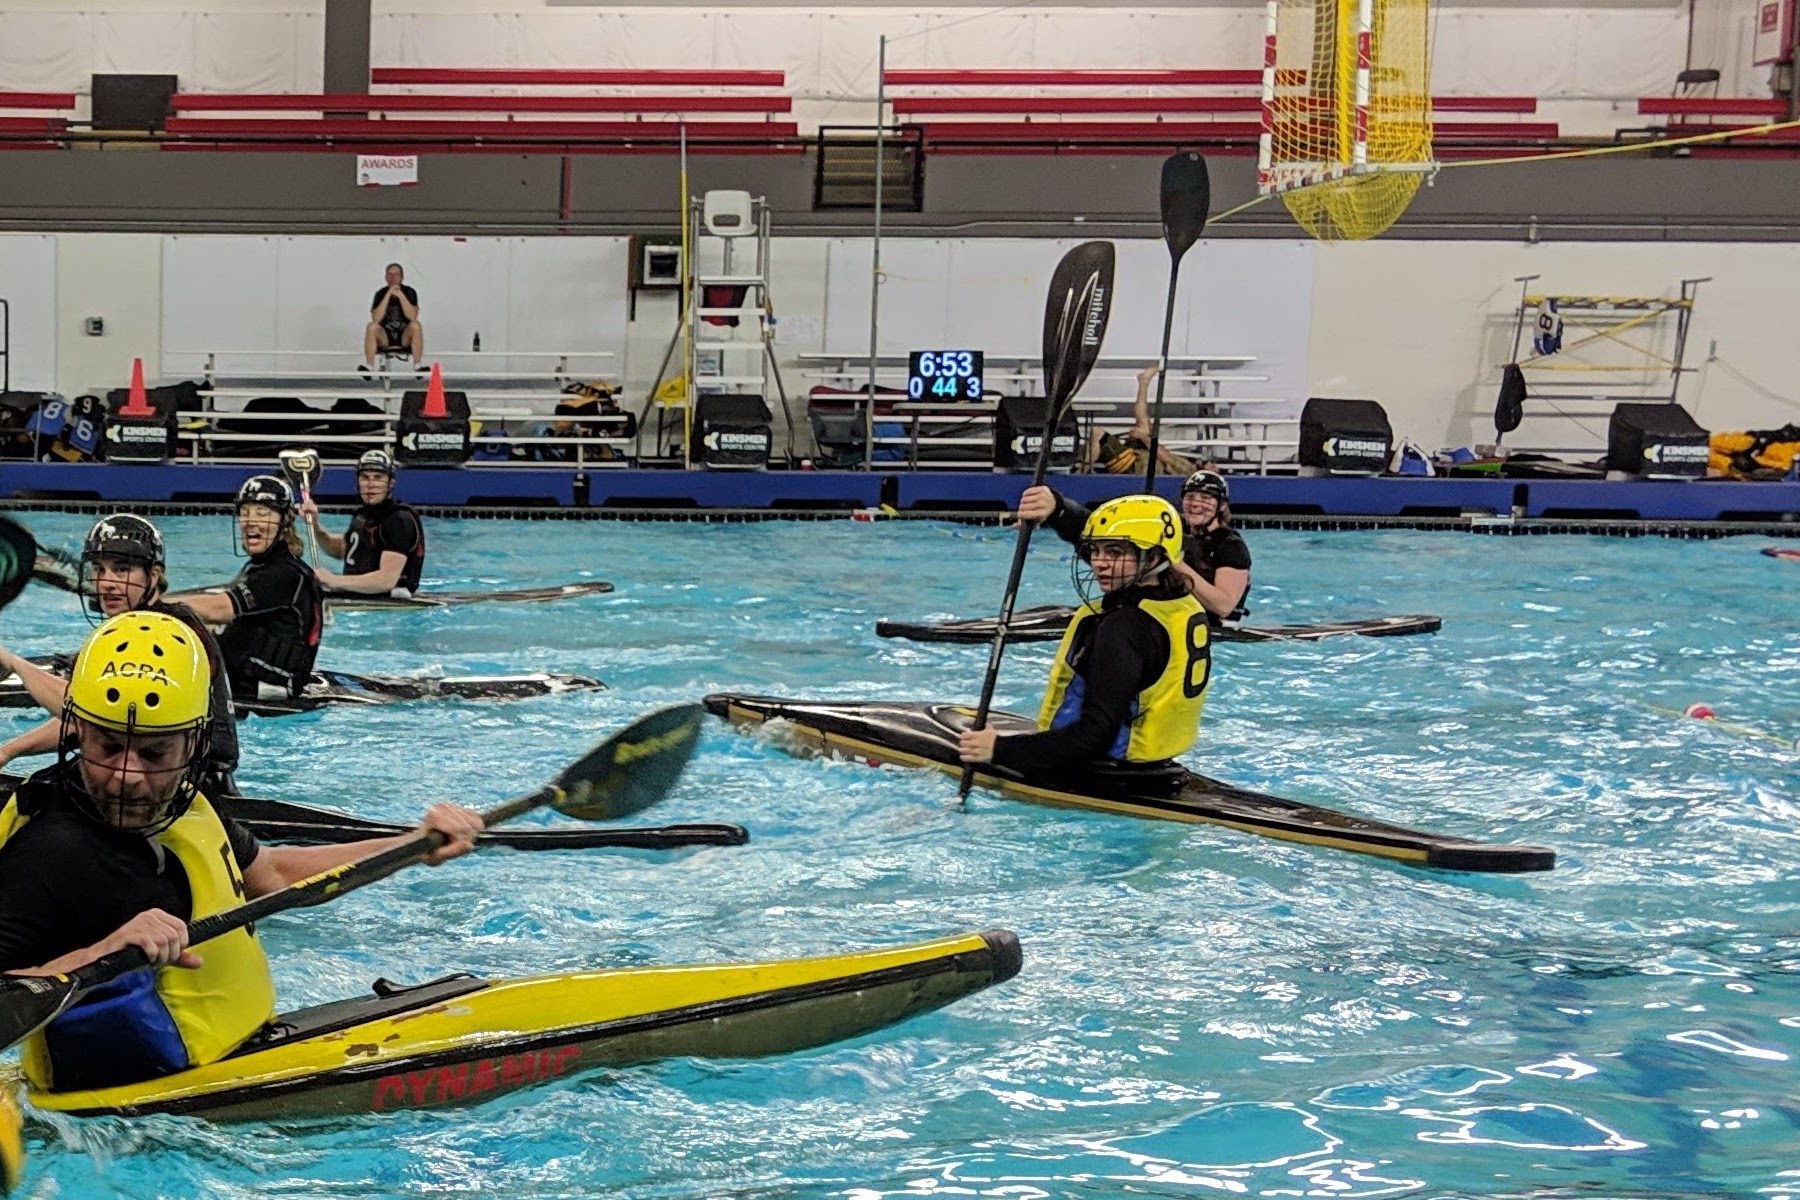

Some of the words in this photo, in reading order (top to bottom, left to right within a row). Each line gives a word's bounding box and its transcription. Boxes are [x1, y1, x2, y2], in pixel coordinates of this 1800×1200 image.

[361, 158, 415, 169] AWARDS
[1084, 288, 1105, 346] mitchell
[919, 352, 974, 377] 6:53
[909, 376, 923, 399] 0
[931, 376, 958, 397] 44
[966, 376, 980, 398] 3
[43, 401, 63, 419] 8
[76, 419, 94, 441] 6
[1161, 511, 1175, 539] 8
[346, 531, 359, 566] 2
[1184, 611, 1212, 699] 8
[101, 660, 169, 687] ACPA
